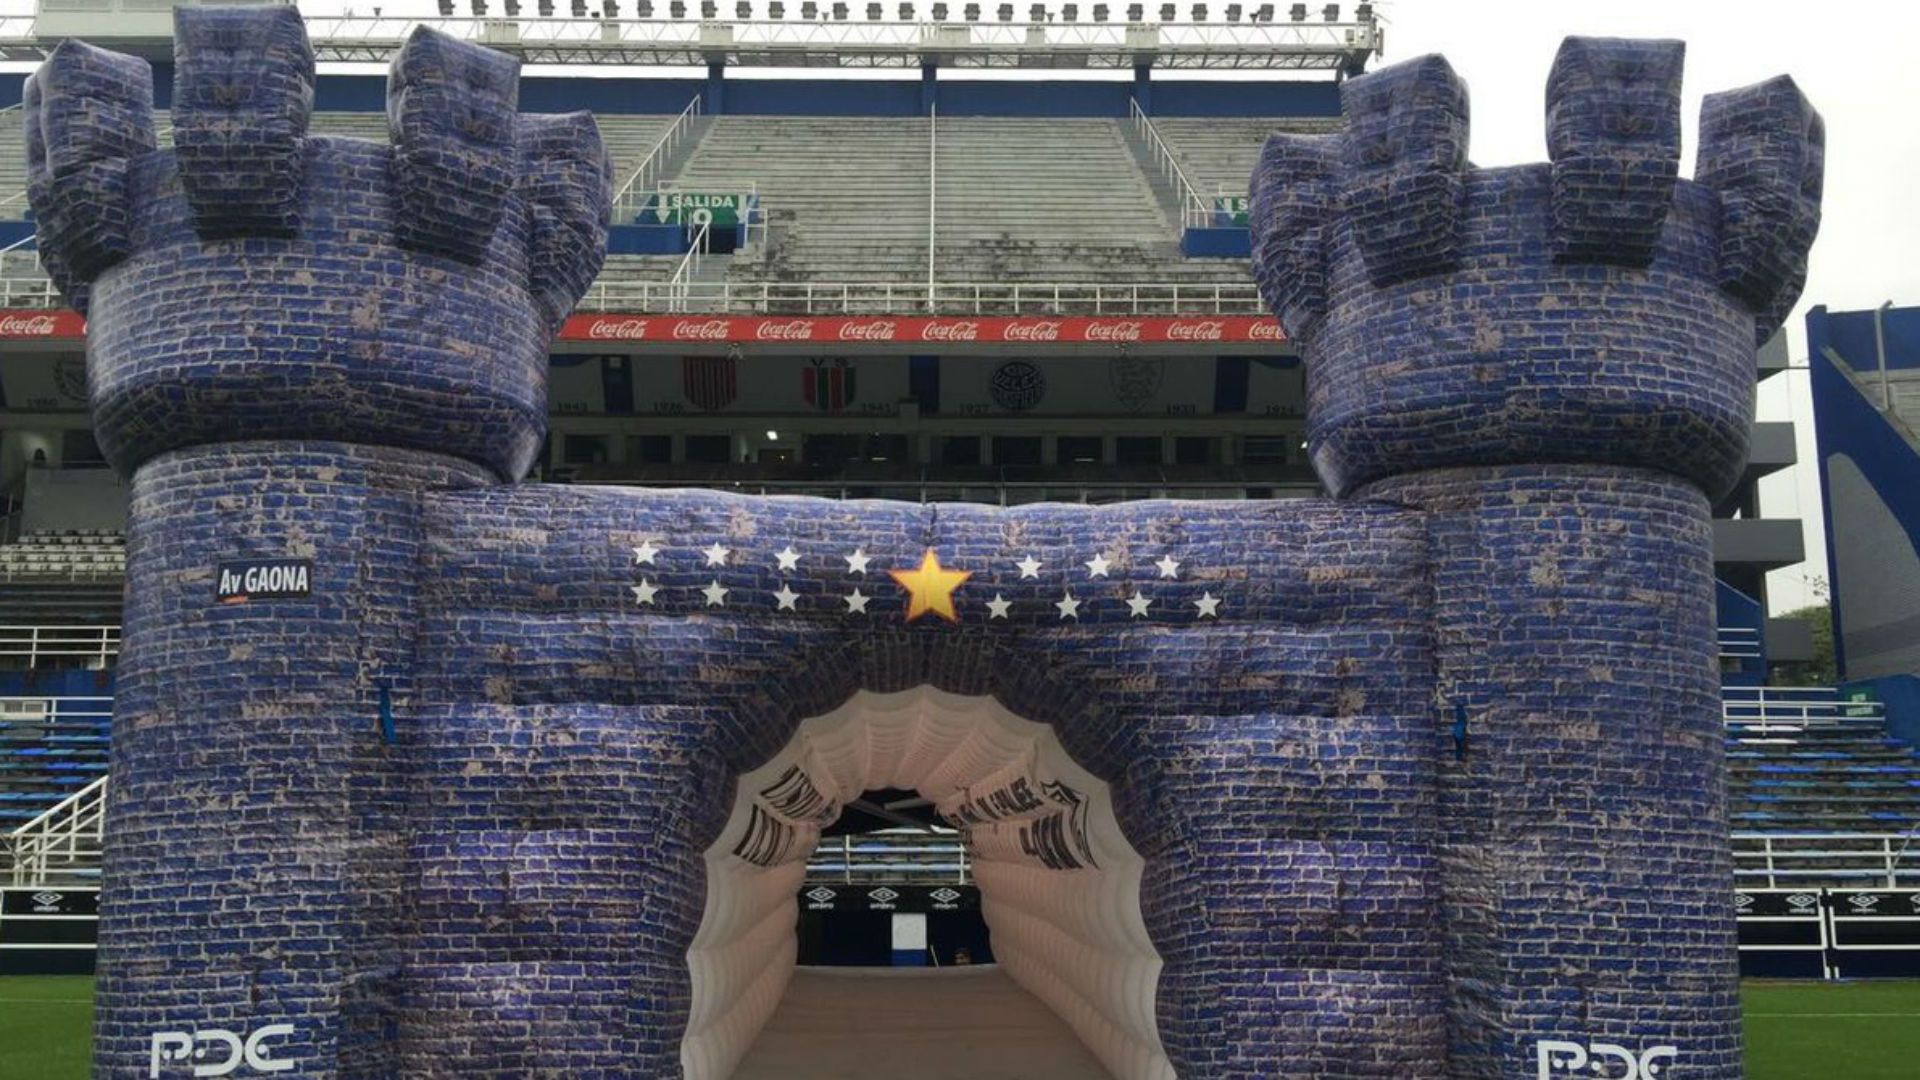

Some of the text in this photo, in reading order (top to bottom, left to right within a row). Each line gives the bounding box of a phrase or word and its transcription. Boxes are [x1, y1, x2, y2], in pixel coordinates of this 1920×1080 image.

[672, 196, 734, 208] SALIDA
[219, 565, 308, 594] Av GAONA
